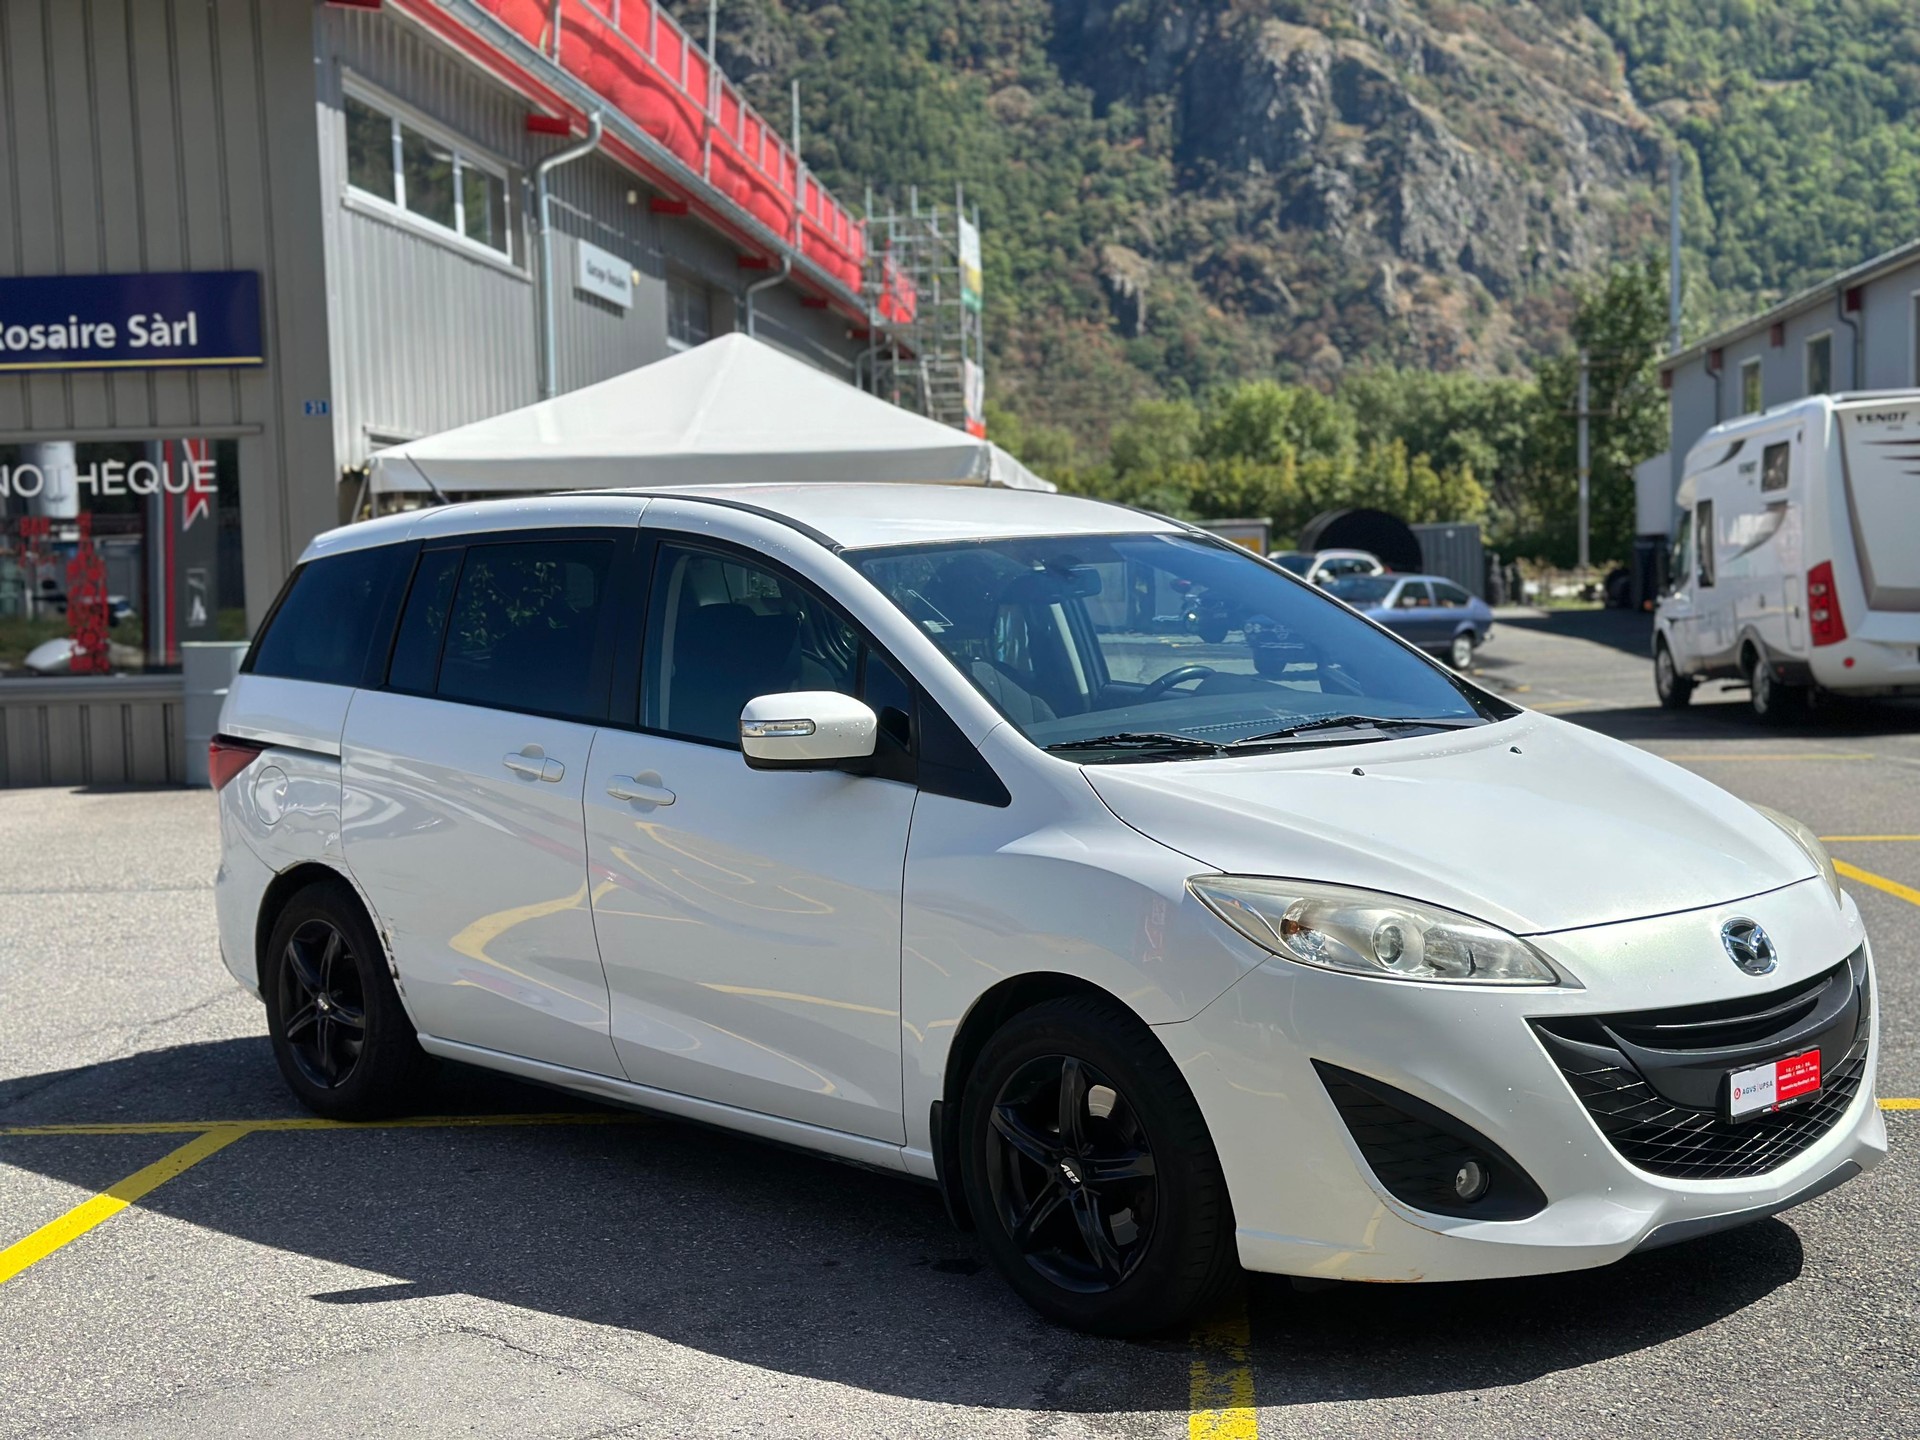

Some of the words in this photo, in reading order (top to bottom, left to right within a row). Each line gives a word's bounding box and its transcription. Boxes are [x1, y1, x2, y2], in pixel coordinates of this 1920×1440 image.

[0, 315, 117, 351] osaire
[127, 311, 198, 347] Sàrl
[1060, 1163, 1081, 1185] AEZ
